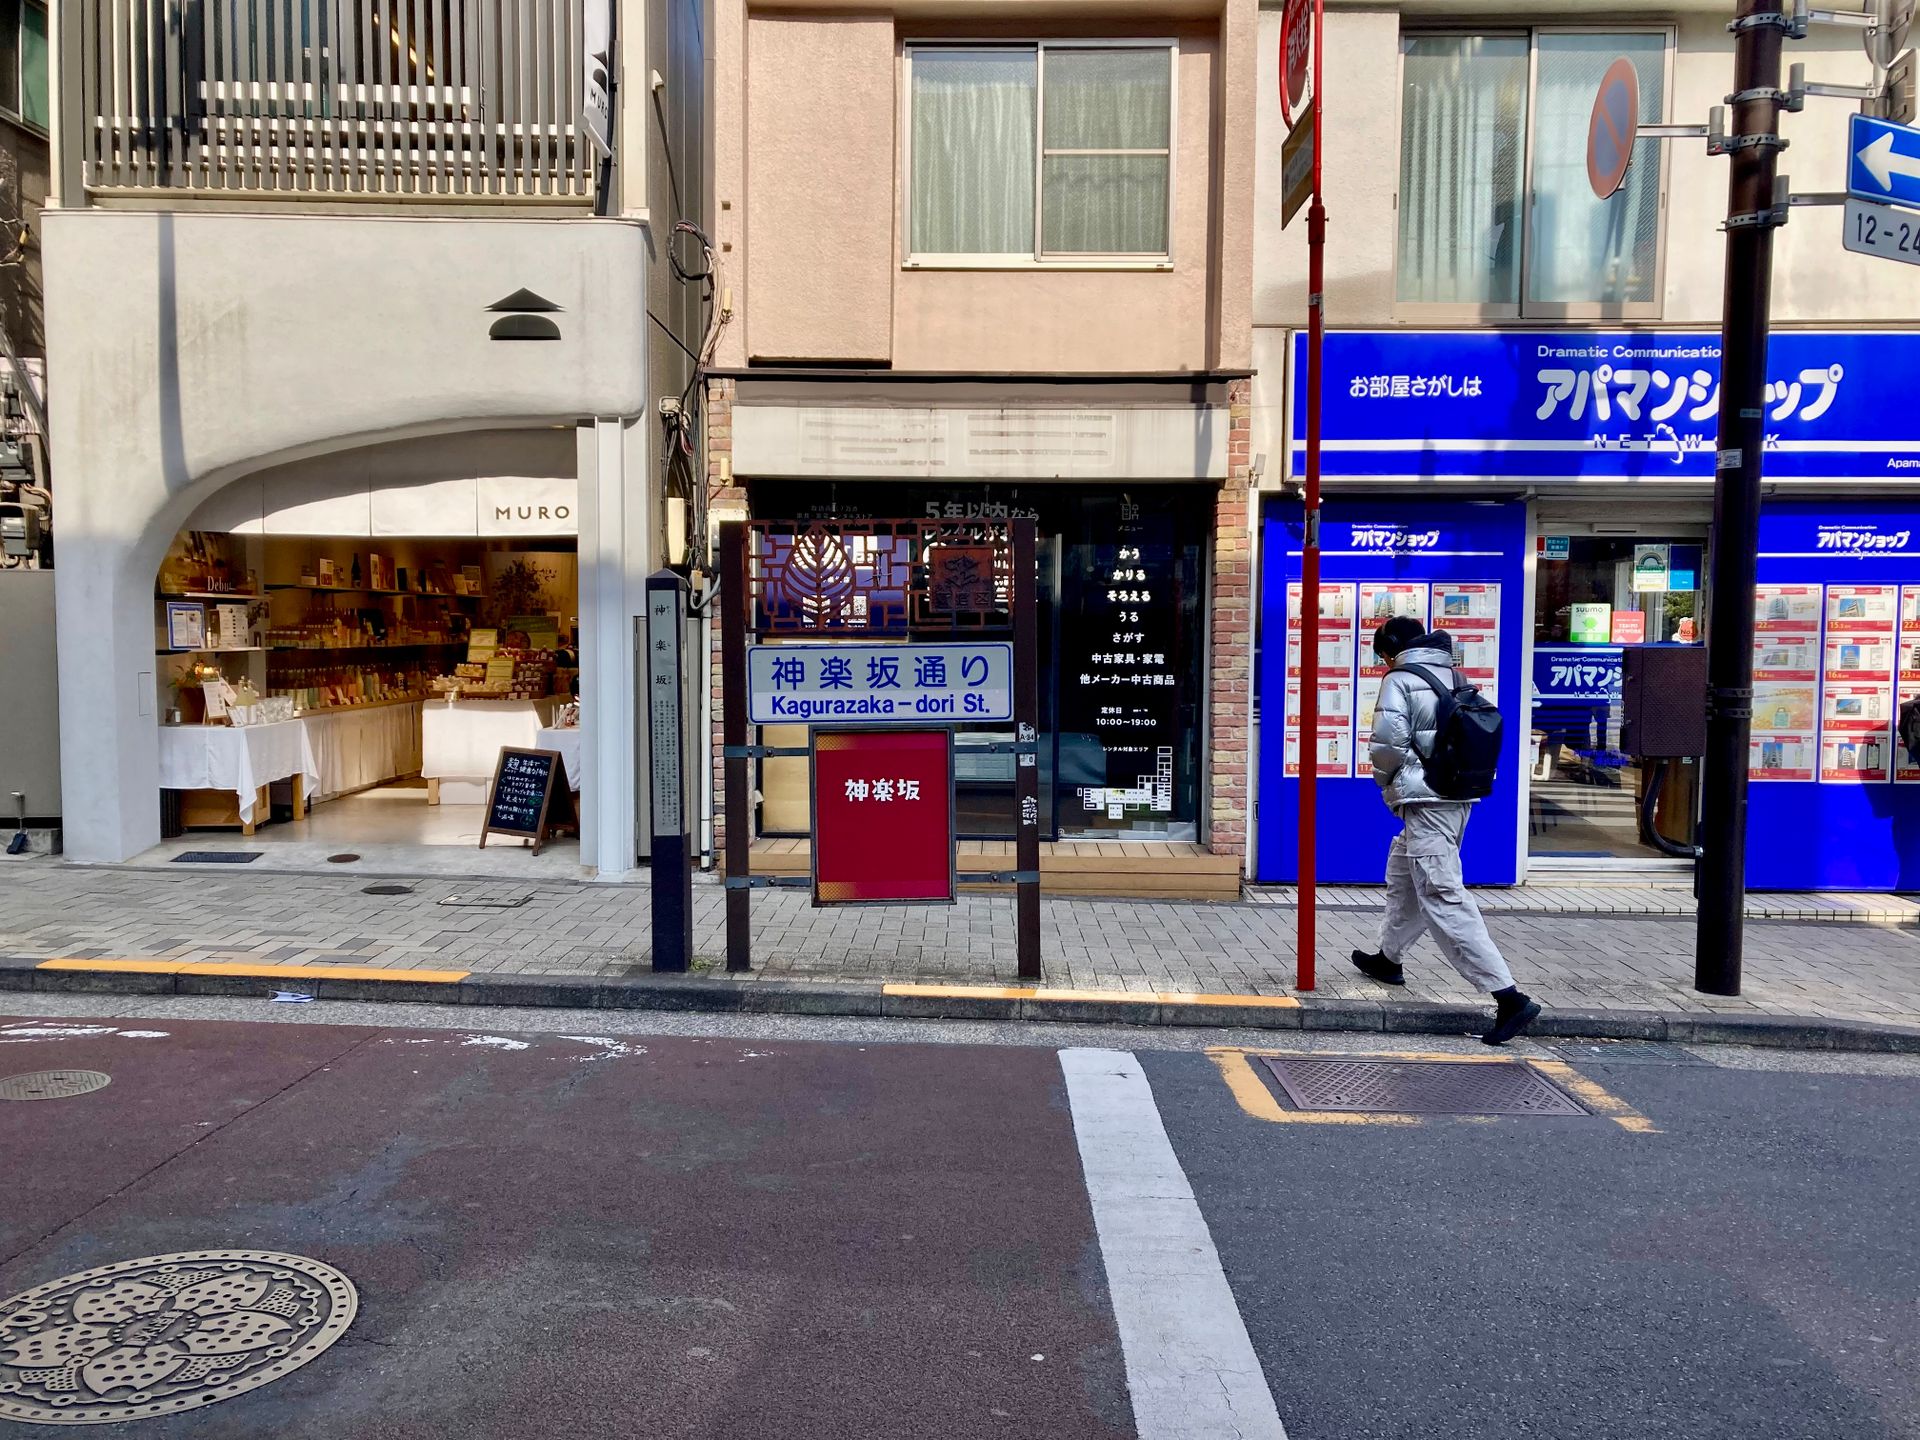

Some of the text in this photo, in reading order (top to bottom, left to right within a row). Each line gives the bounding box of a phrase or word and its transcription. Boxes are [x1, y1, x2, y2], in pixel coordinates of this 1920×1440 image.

[1537, 345, 1723, 358] Dramatic Communicatio
[1350, 374, 1482, 398] お部屋さがしは
[1535, 362, 1844, 421] アパマンシップ
[495, 505, 570, 520] MURO
[1351, 529, 1440, 547] アパマンショップ
[1816, 530, 1910, 548] アパマンショップ
[1119, 547, 1140, 560] かう
[1112, 569, 1146, 581] かりる
[1106, 590, 1151, 602] そろえる
[1119, 611, 1139, 622] うる
[654, 603, 669, 685] 神楽坂
[1112, 632, 1145, 643] さがす
[1091, 653, 1165, 665] 中古家具・家電
[771, 655, 990, 691] 神楽坂通り
[1080, 673, 1175, 686] 他メーカー中古商品
[963, 693, 991, 713] St.
[1101, 706, 1122, 714] 定休日
[844, 778, 921, 802] 神楽坂
